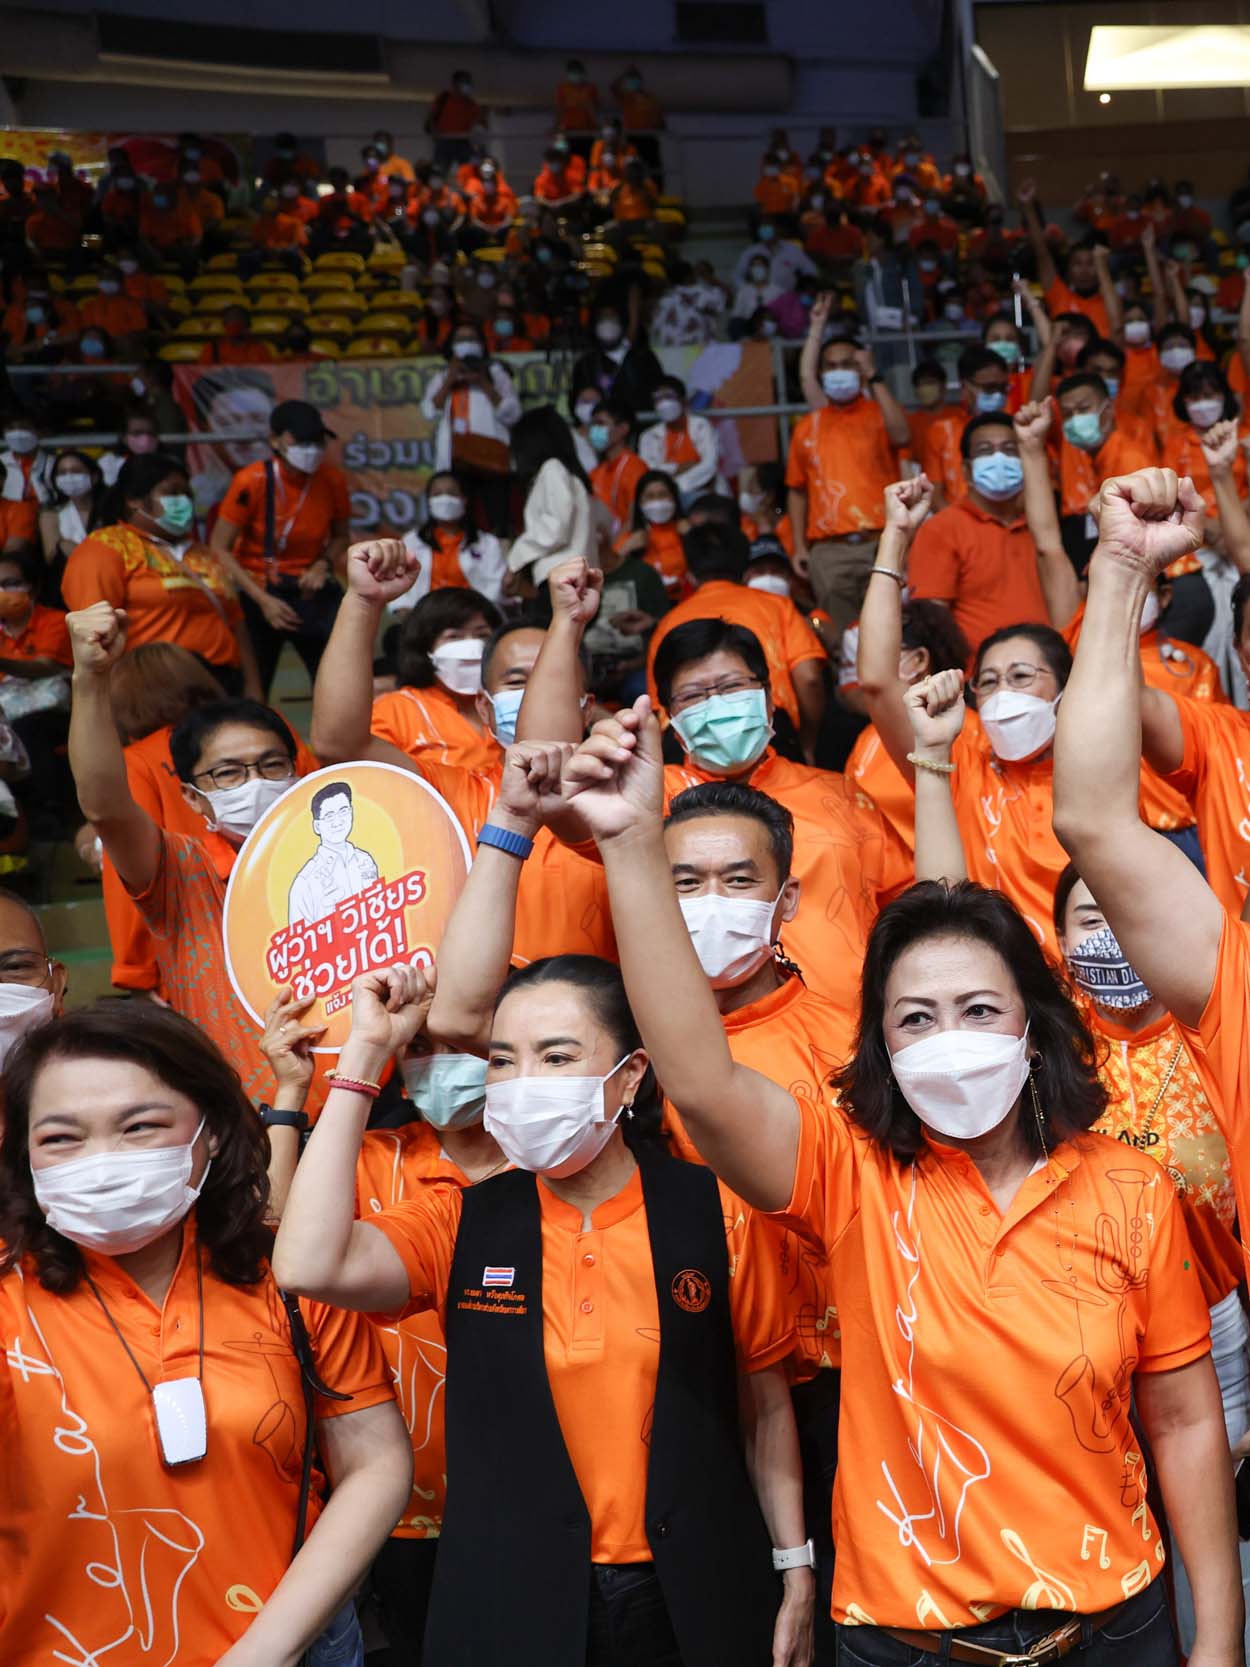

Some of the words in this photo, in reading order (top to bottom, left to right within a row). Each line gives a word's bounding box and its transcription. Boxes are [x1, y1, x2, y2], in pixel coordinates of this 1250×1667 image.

[269, 919, 333, 980] ผู้ว่าฯ
[339, 874, 423, 935] วิเชียร
[294, 916, 405, 1001] ช่วยได้!
